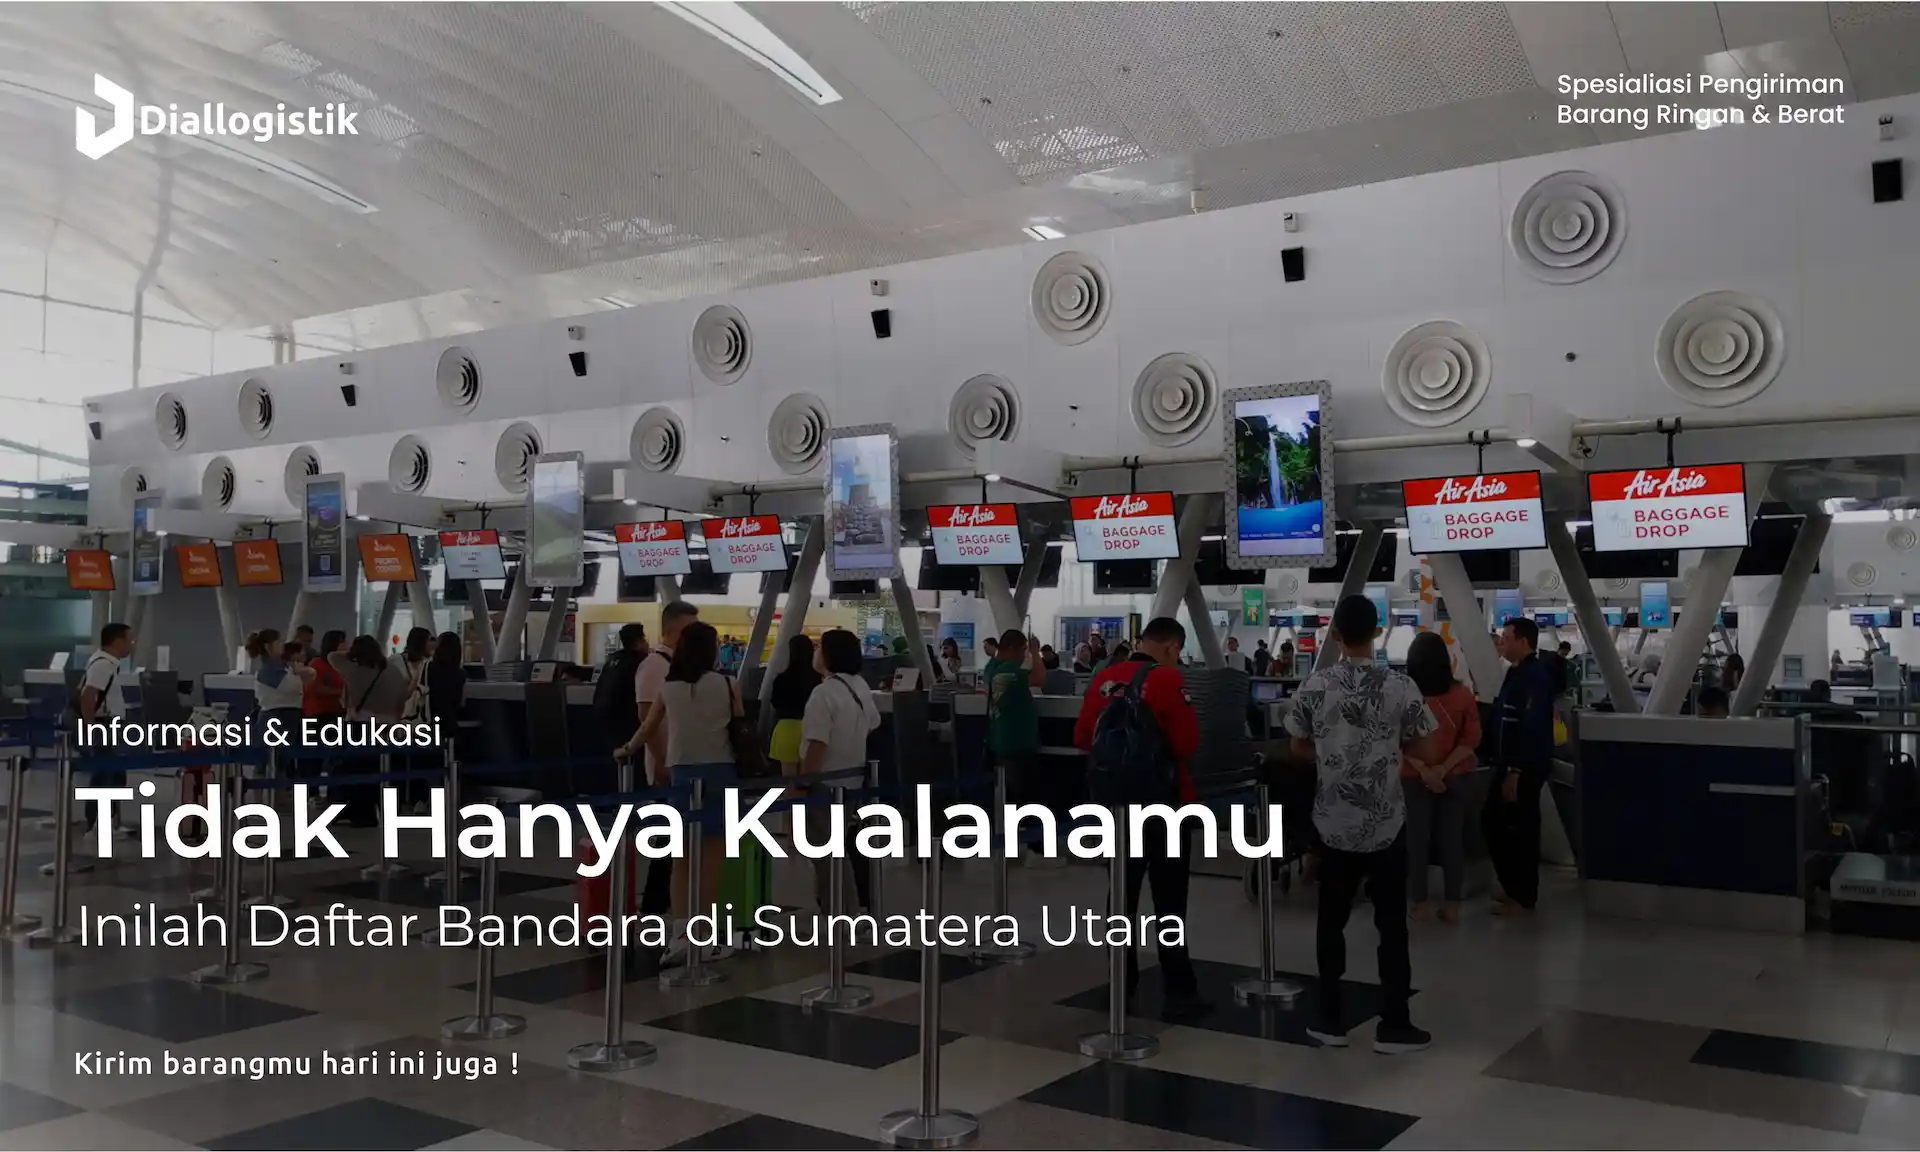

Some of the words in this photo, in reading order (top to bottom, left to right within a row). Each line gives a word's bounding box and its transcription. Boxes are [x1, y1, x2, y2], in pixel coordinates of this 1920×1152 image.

[1444, 509, 1529, 525] BAGGAGE
[1634, 505, 1729, 522] BAGGAGE
[1102, 524, 1166, 538] BAGGAGE
[1446, 526, 1494, 540] DROP
[1635, 524, 1690, 539] DROP
[956, 533, 1011, 544] BAGGAGE
[727, 542, 776, 554] BAGGAGE
[1104, 540, 1141, 550] DROP
[638, 547, 681, 558] BAGGAGE
[958, 546, 990, 556] DROP
[639, 559, 665, 568] DROP
[730, 554, 757, 565] DROP
